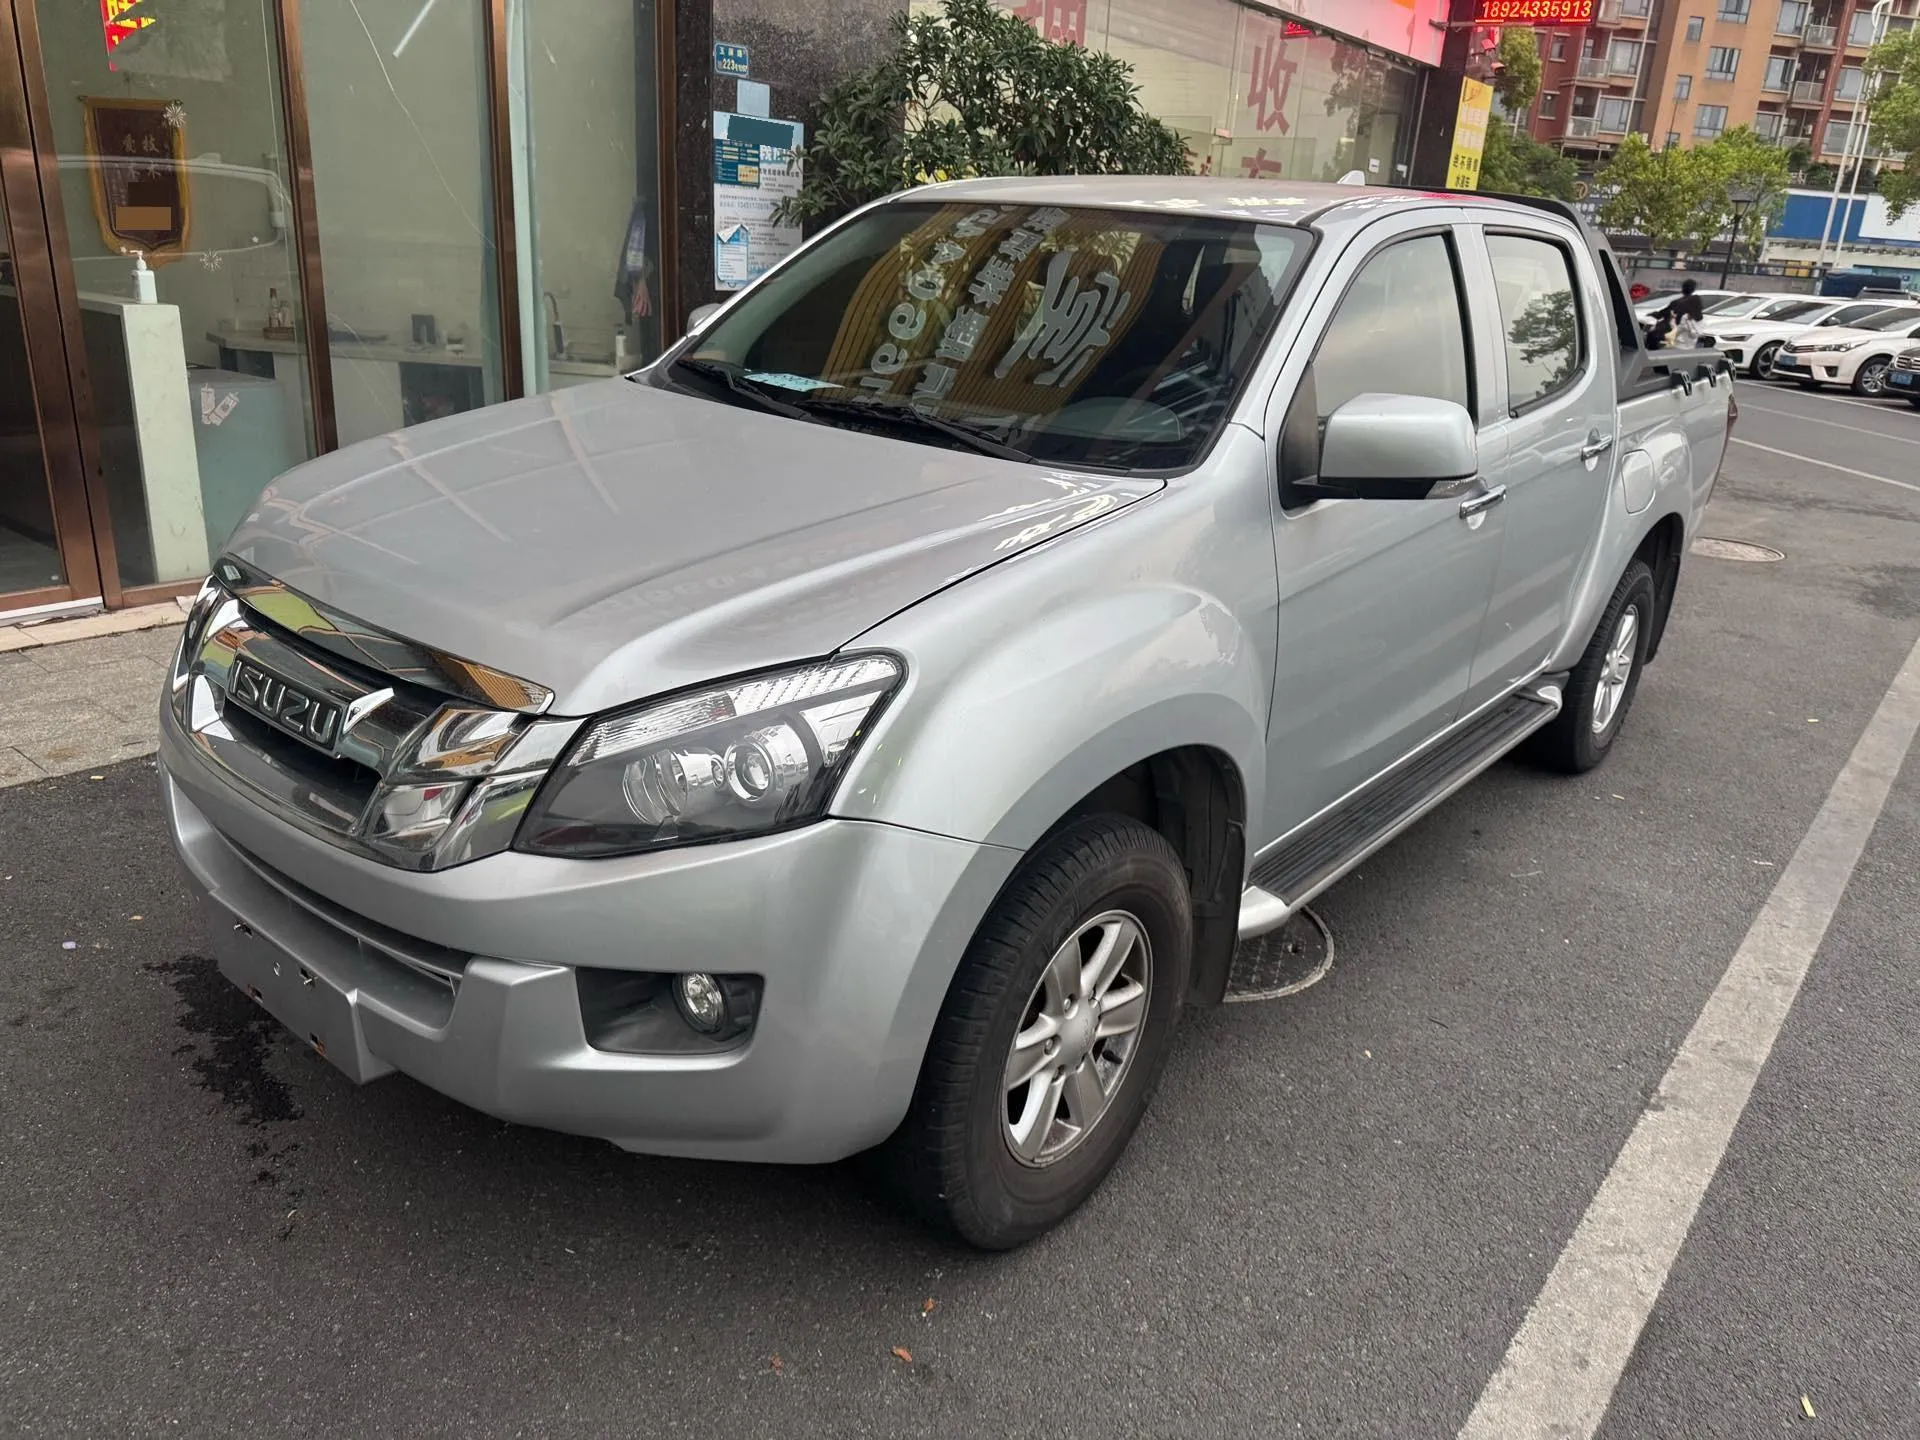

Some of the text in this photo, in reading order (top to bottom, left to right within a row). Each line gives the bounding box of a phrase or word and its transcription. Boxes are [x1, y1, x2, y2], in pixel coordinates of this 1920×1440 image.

[1482, 0, 1592, 18] 18924335913
[1247, 33, 1297, 135] 收
[232, 658, 338, 744] ISUZU
